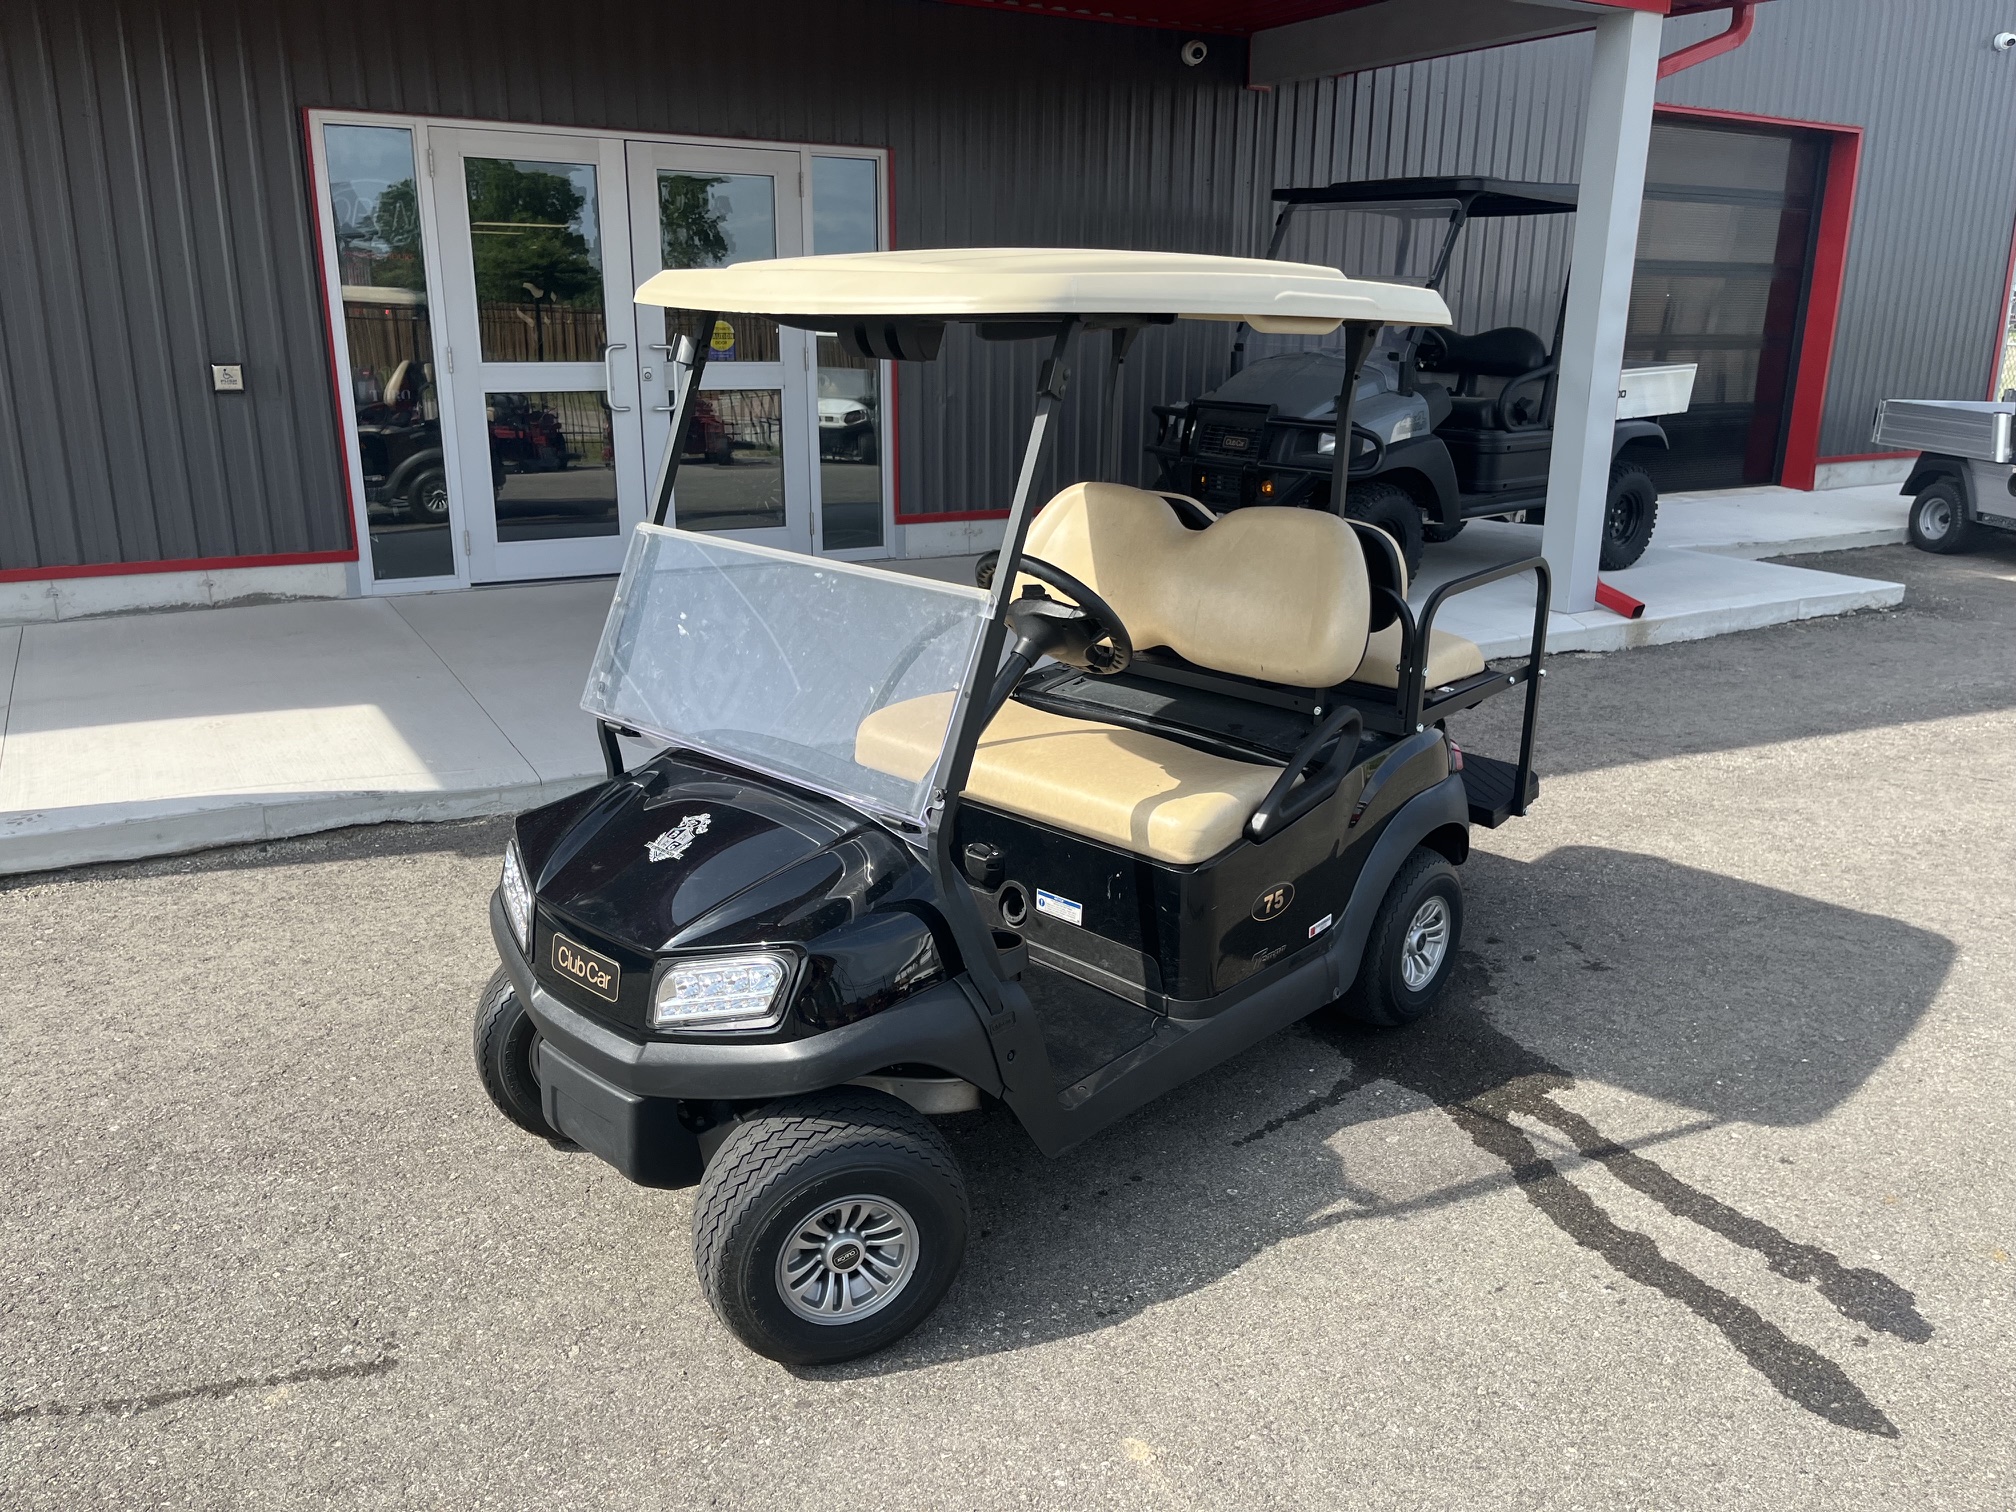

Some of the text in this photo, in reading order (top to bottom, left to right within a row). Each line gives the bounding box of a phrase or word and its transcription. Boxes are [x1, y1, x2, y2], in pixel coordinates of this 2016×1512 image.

[1263, 888, 1284, 914] 75
[558, 946, 612, 990] Club Car
